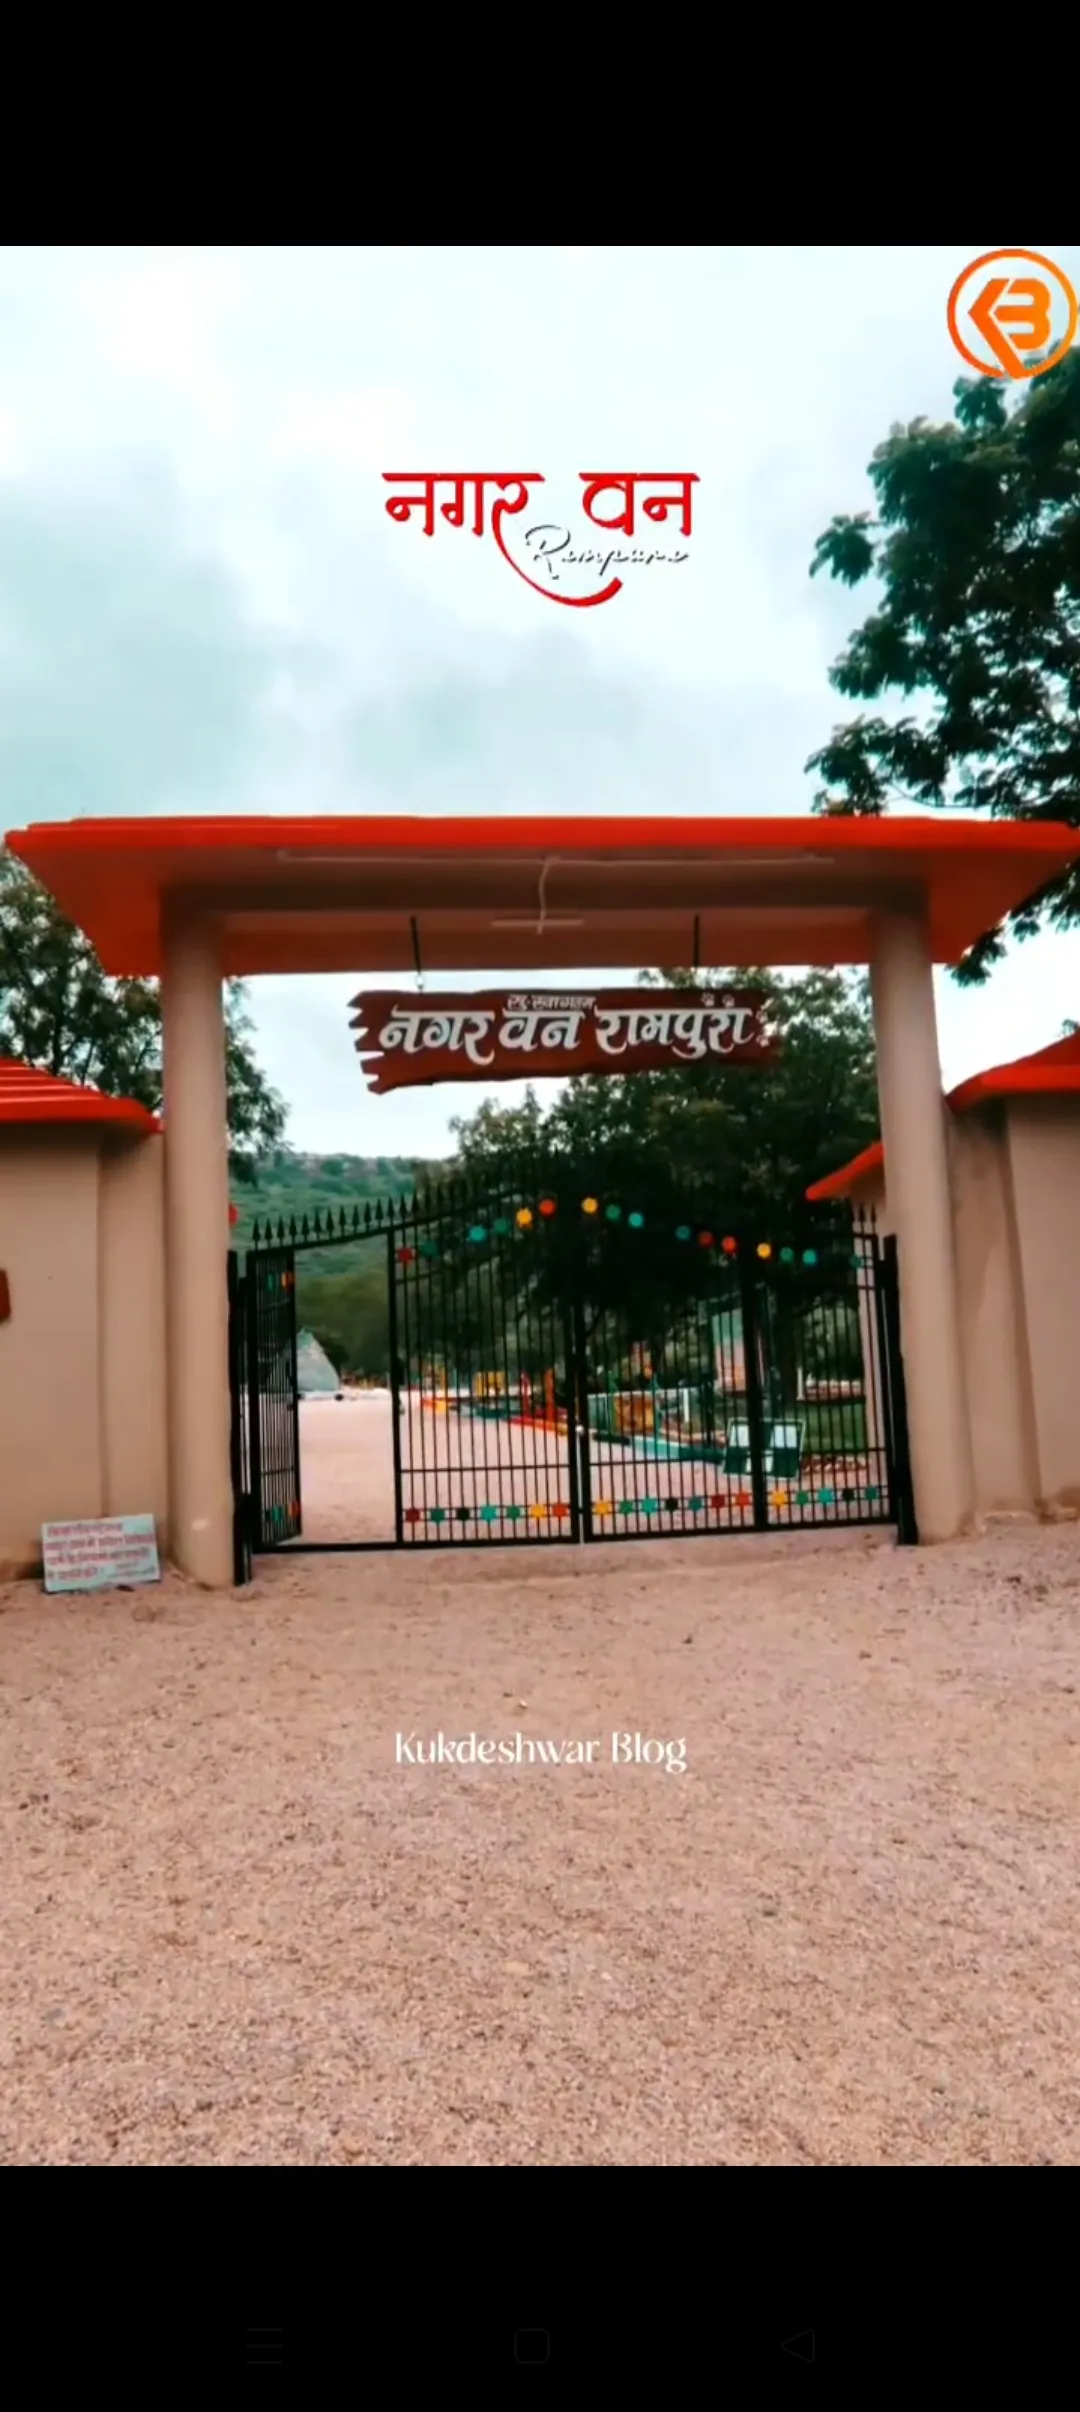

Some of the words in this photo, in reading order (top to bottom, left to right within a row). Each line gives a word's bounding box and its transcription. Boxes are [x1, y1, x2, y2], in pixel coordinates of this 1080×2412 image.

[378, 1004, 495, 1066] नगर
[498, 1007, 585, 1052] वन
[594, 1004, 754, 1060] रामपुरा
